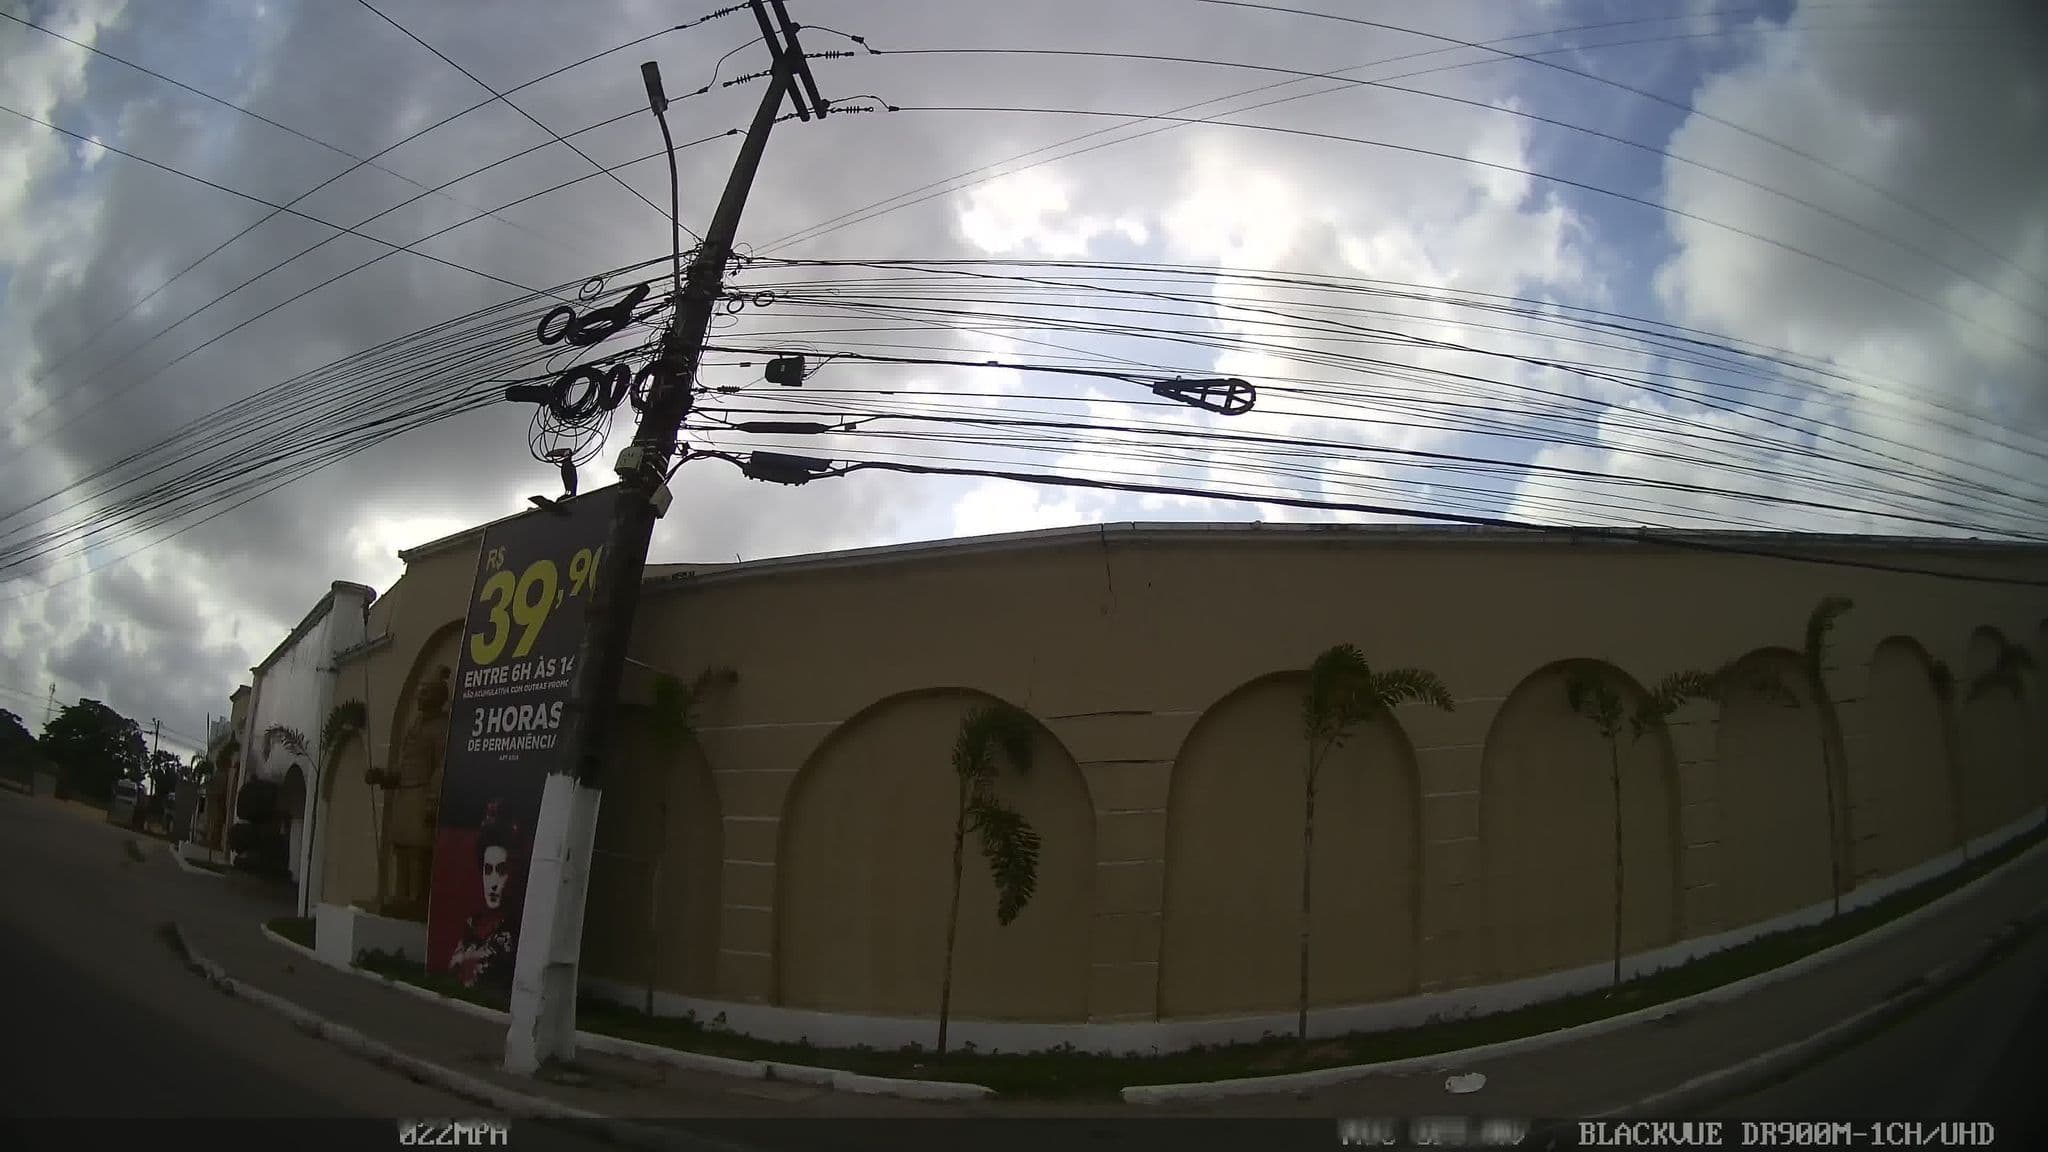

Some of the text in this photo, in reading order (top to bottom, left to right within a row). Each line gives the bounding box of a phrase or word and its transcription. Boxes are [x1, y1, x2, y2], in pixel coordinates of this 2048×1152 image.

[464, 665, 509, 688] ENTRE
[511, 662, 532, 682] 6H
[534, 655, 557, 679] ÀS
[472, 701, 563, 737] 3 HORAS
[467, 739, 480, 752] DE
